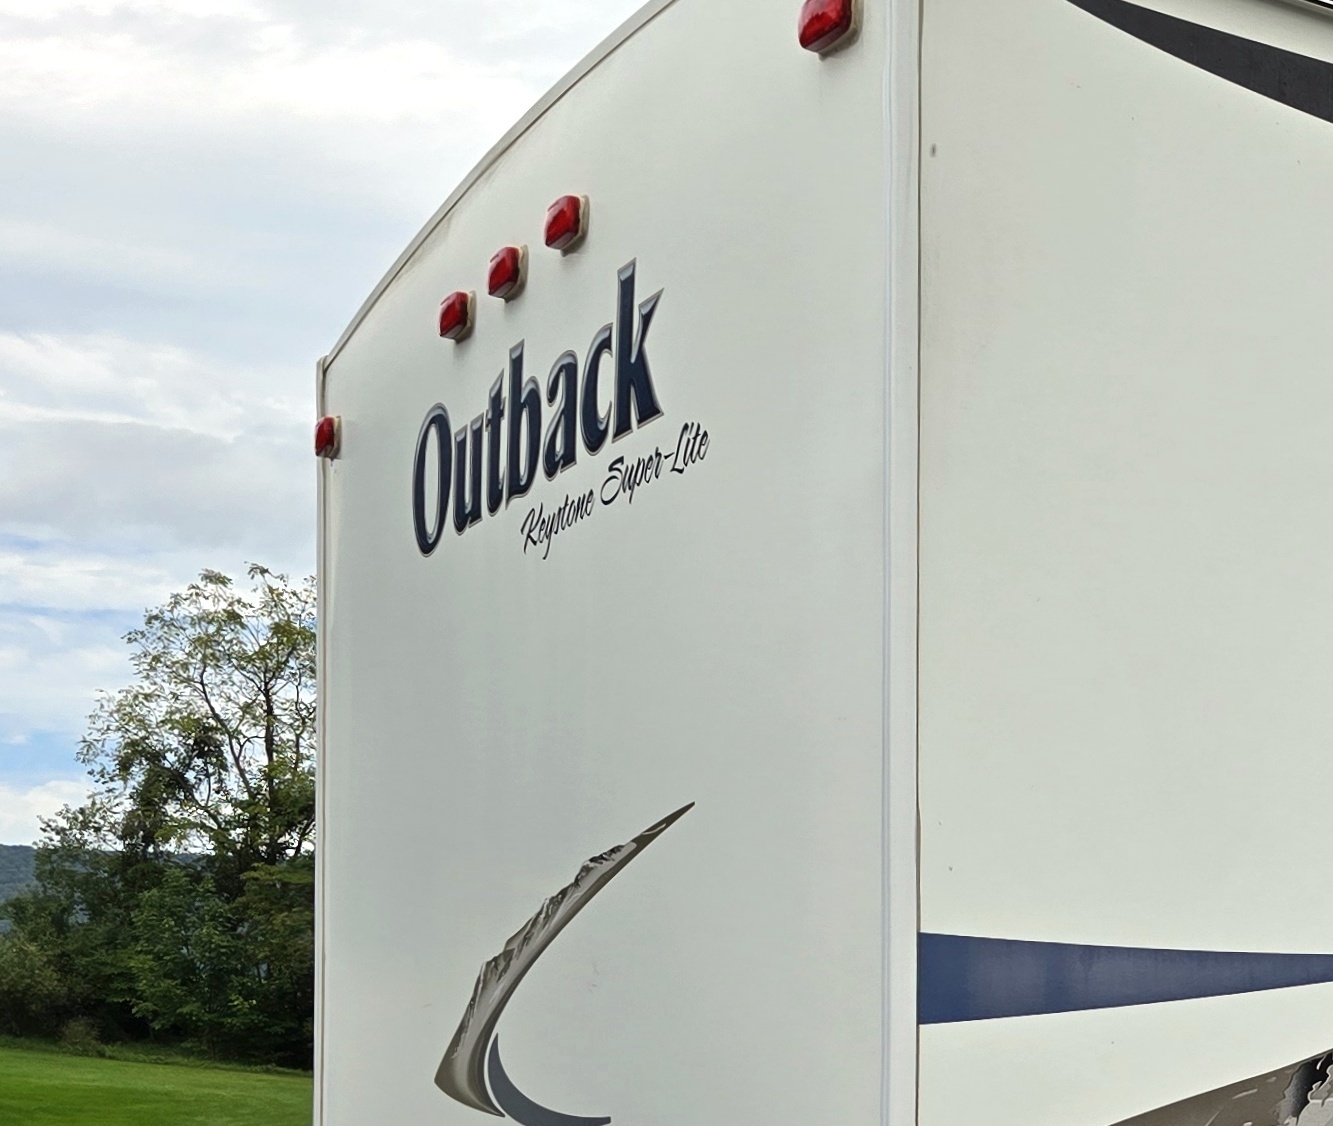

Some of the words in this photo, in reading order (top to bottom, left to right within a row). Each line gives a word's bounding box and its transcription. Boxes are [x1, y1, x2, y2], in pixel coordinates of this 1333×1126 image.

[411, 257, 665, 558] Outback
[520, 486, 595, 561] Keystone
[600, 421, 710, 505] Super-Lite
